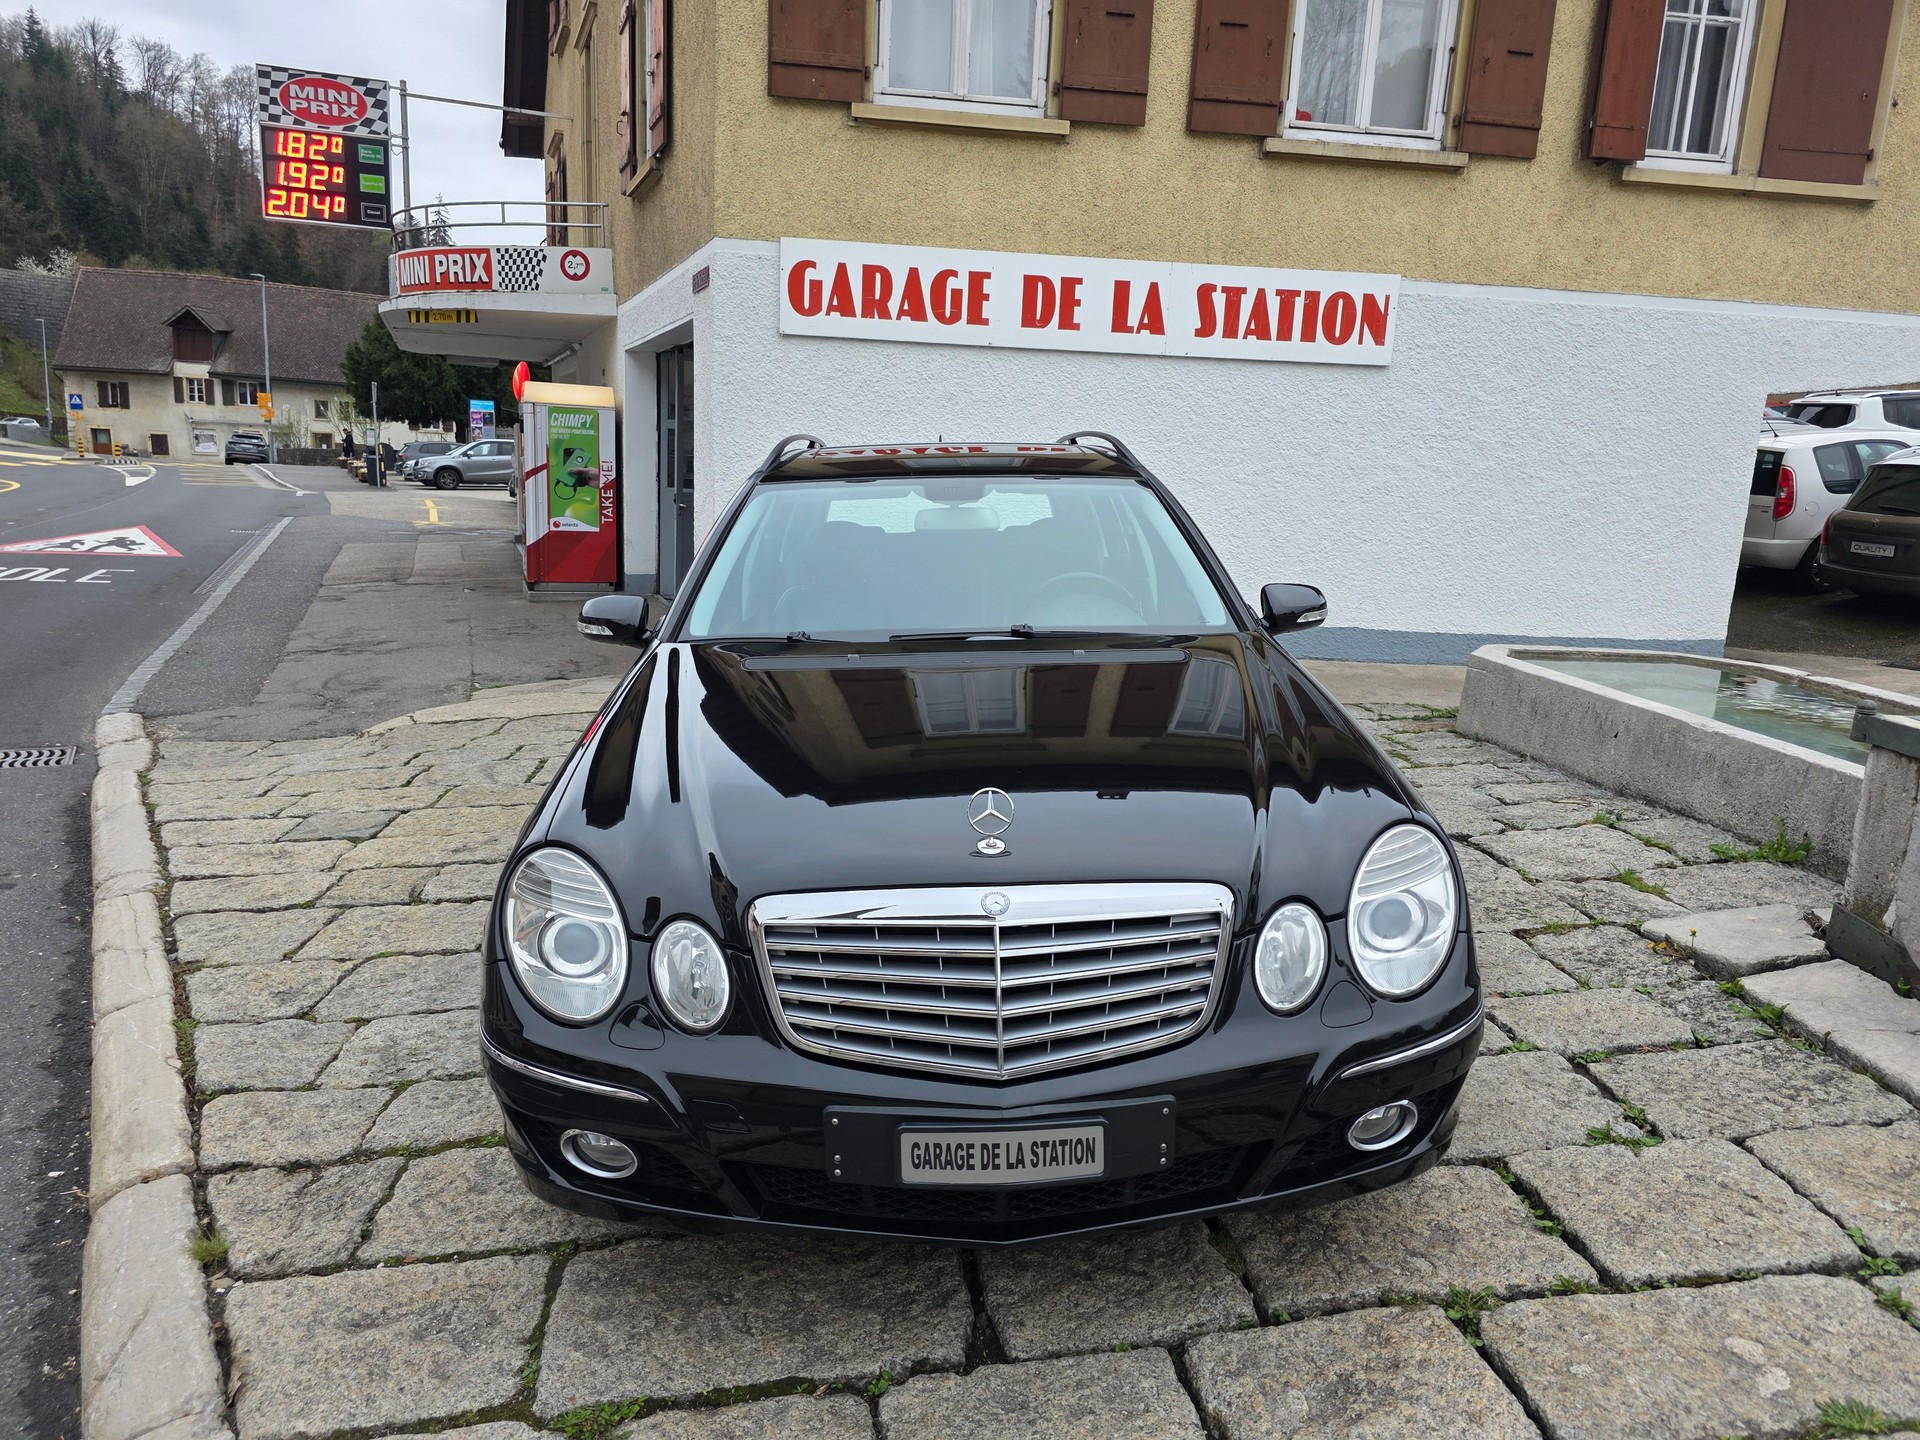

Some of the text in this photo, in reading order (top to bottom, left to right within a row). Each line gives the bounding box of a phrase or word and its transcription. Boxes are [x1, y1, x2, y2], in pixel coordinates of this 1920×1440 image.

[289, 84, 358, 105] MINI
[289, 99, 359, 119] PRIX
[400, 253, 489, 287] MINI PRIX
[787, 259, 1391, 347] GARAGE DE LA STATION
[550, 412, 593, 428] CHIMPY
[601, 460, 613, 525] TAKE ME!
[1853, 543, 1888, 555] QUALITY
[0, 566, 135, 584] OLE
[910, 1136, 1096, 1171] GARAGE DE LA STATION
